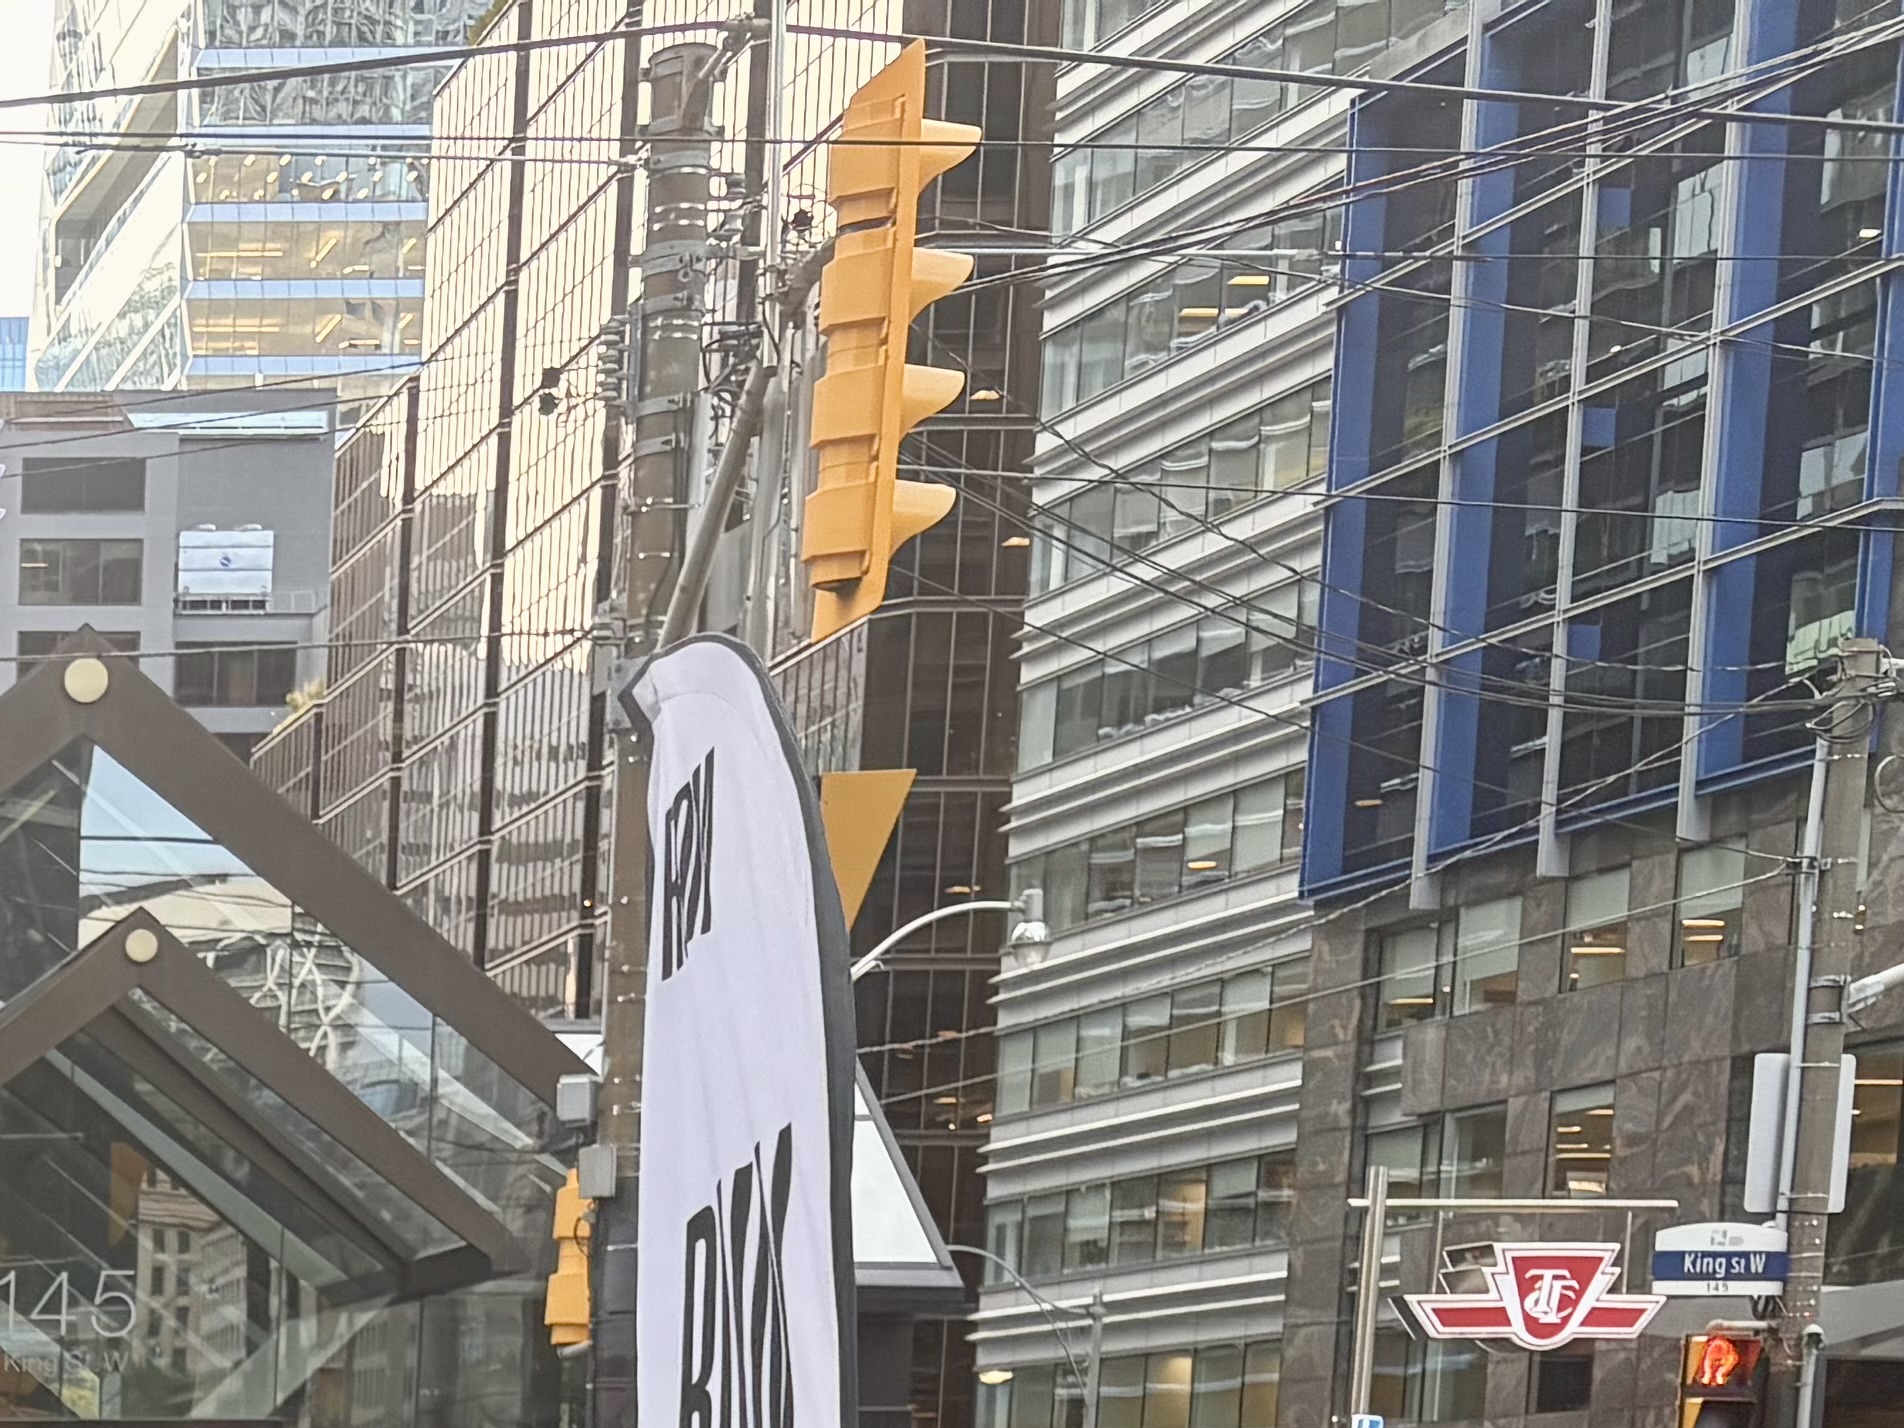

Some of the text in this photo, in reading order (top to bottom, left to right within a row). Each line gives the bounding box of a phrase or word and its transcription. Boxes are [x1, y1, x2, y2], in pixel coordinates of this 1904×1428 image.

[1683, 1252, 1729, 1278] King
[1748, 1252, 1767, 1274] W
[3, 1354, 61, 1377] King
[102, 1352, 130, 1373] W
